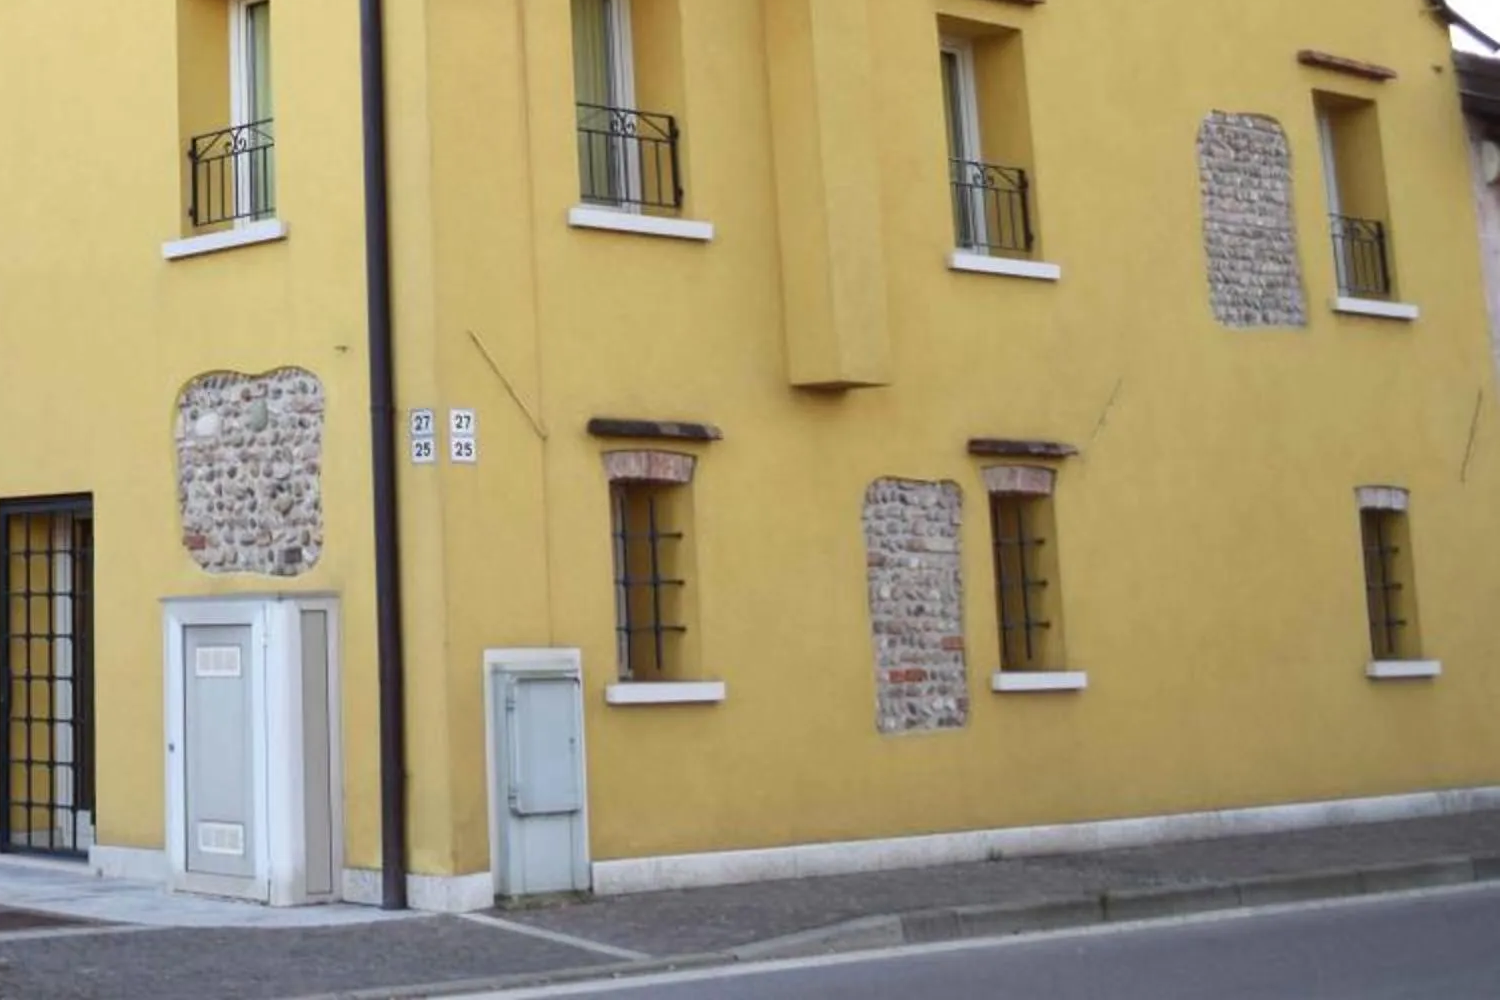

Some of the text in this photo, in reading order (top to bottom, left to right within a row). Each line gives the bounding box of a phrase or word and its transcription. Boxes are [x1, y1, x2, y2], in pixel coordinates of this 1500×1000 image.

[414, 415, 430, 431] 27
[455, 414, 471, 429] 27
[415, 442, 431, 457] 25
[455, 442, 473, 457] 25
